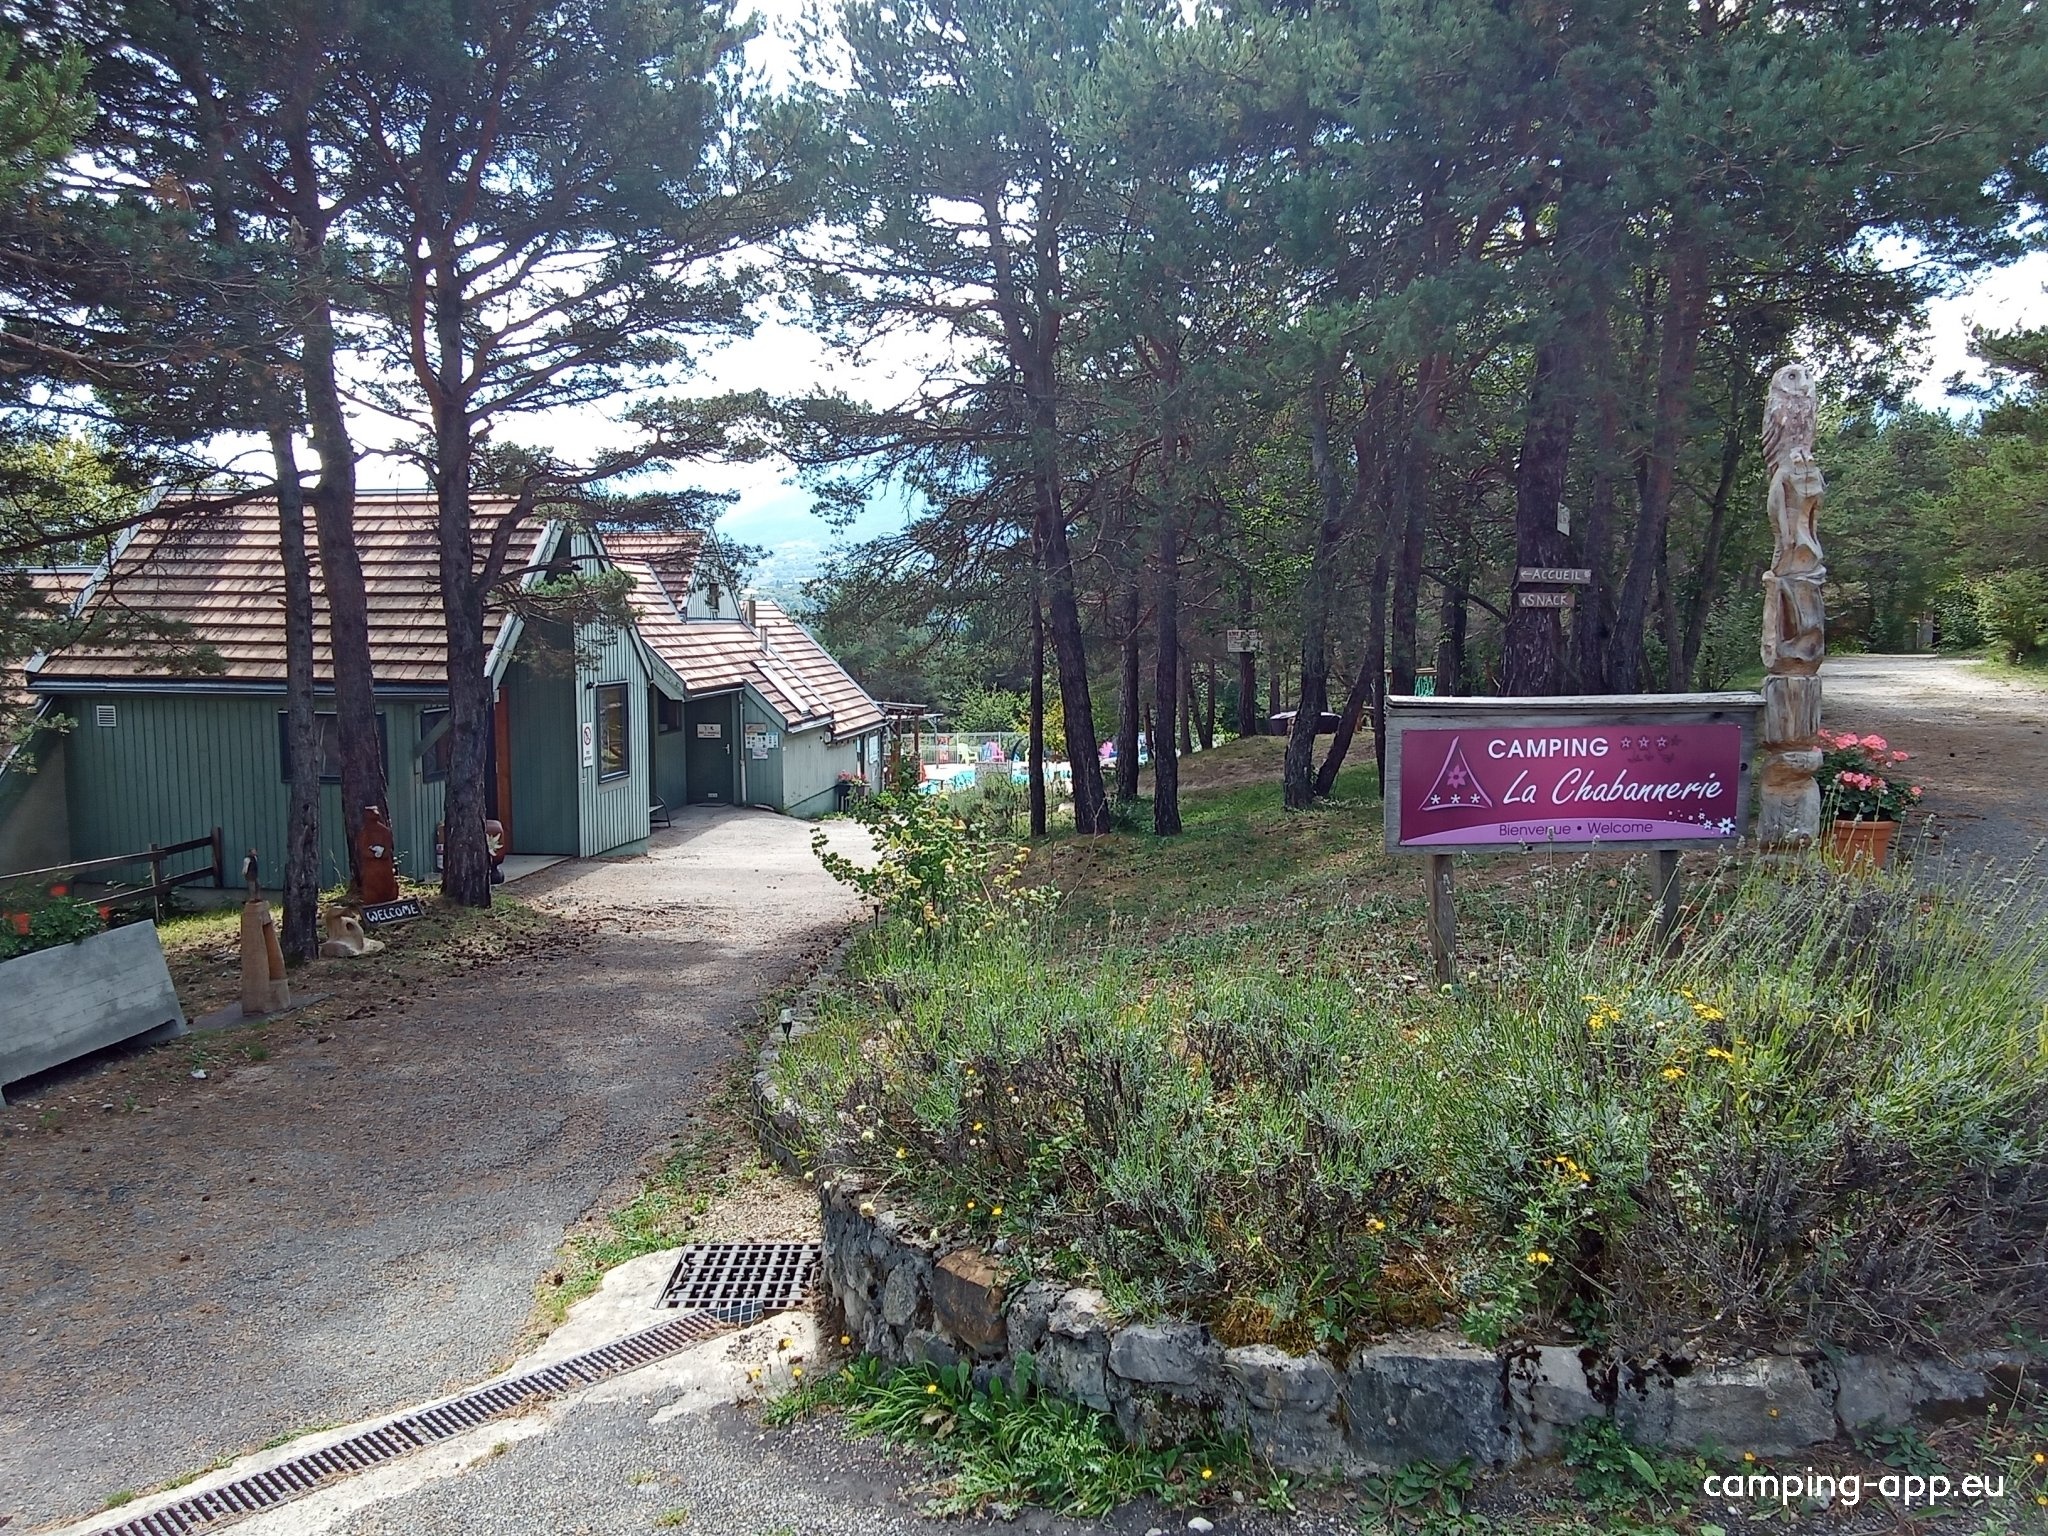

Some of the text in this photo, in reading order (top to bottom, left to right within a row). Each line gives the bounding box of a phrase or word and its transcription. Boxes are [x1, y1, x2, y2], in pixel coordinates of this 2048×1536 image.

[1531, 569, 1581, 580] ACCUEIL
[1526, 594, 1568, 606] SNACK
[1488, 737, 1609, 759] CAMPING
[1503, 767, 1723, 805] La Chabannerie
[1587, 822, 1654, 834] Welcome
[365, 905, 419, 923] WELCOME
